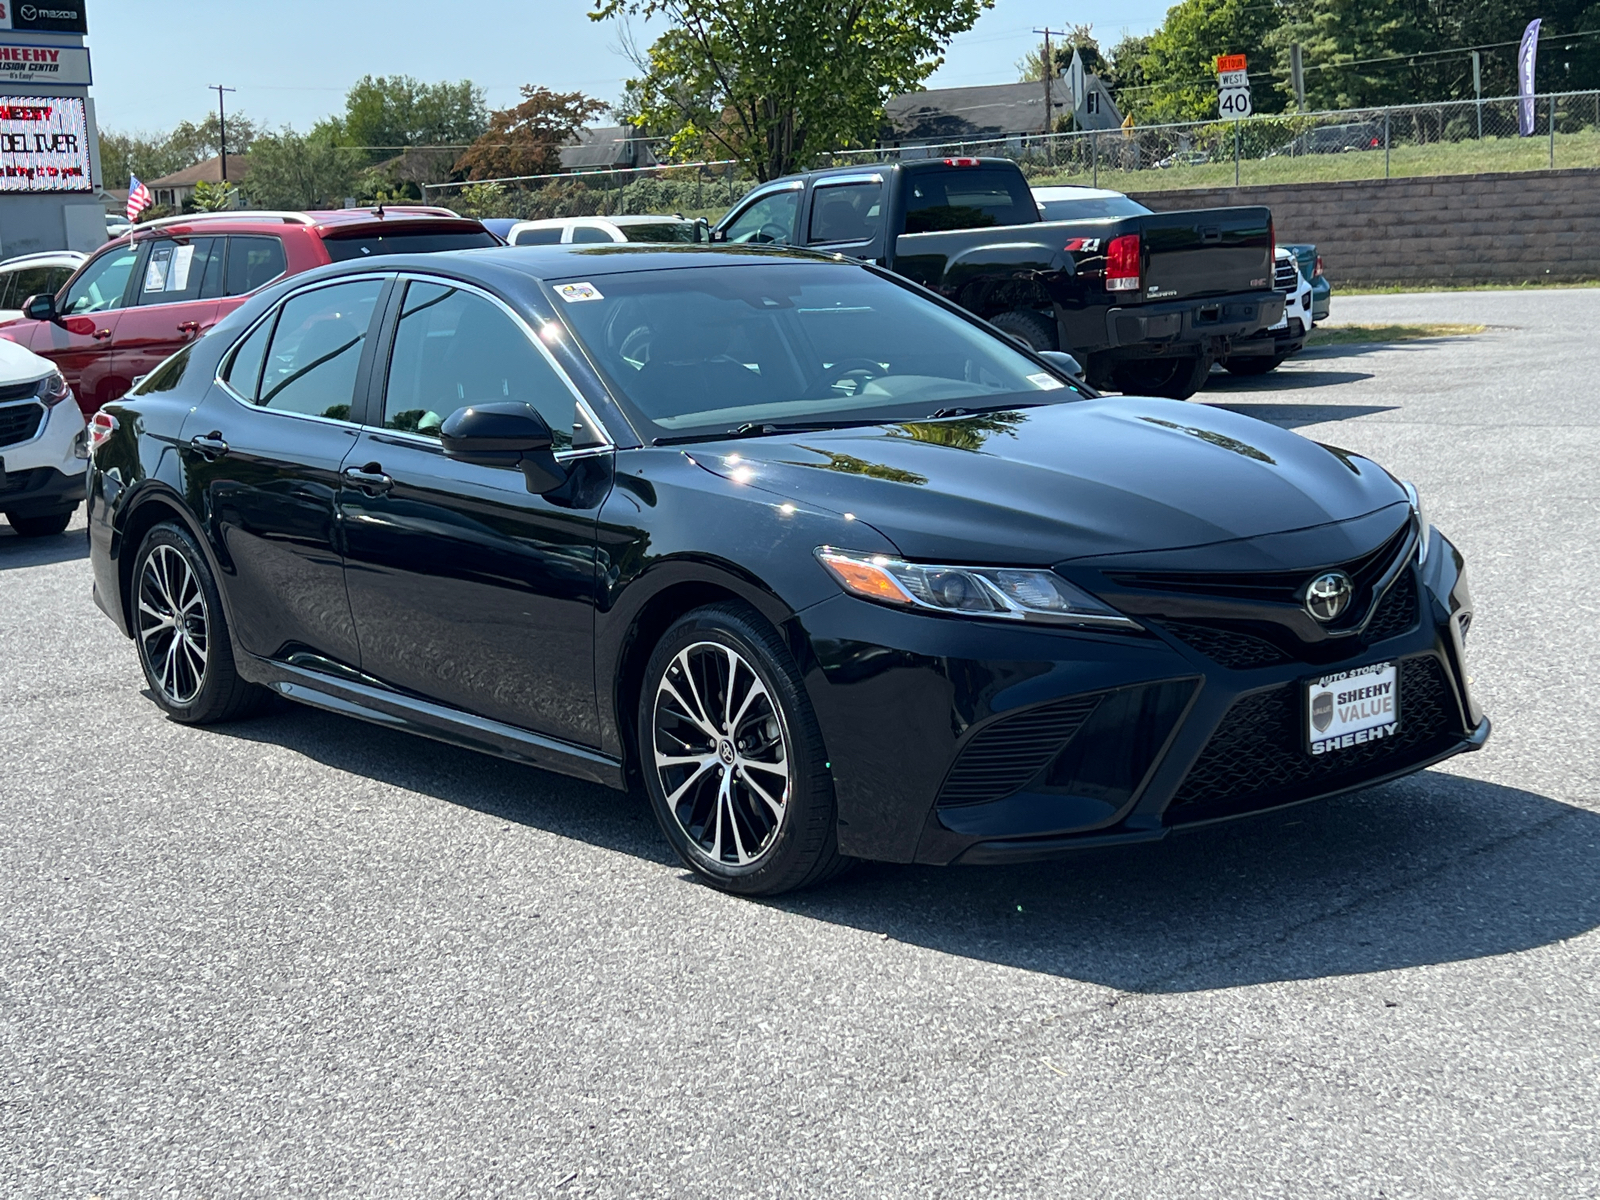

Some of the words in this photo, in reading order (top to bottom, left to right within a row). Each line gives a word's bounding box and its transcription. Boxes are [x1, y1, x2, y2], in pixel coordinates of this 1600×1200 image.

[38, 9, 78, 20] mazda
[28, 63, 59, 72] CENTER
[1220, 58, 1244, 70] DETOUR
[1222, 74, 1243, 84] WEST
[1222, 94, 1248, 113] 40
[1064, 236, 1100, 252] Z71
[1318, 672, 1347, 685] AUTO
[1337, 681, 1392, 705] SHEEHY
[1338, 696, 1392, 723] VALUE
[1312, 722, 1398, 755] SHEEHY
